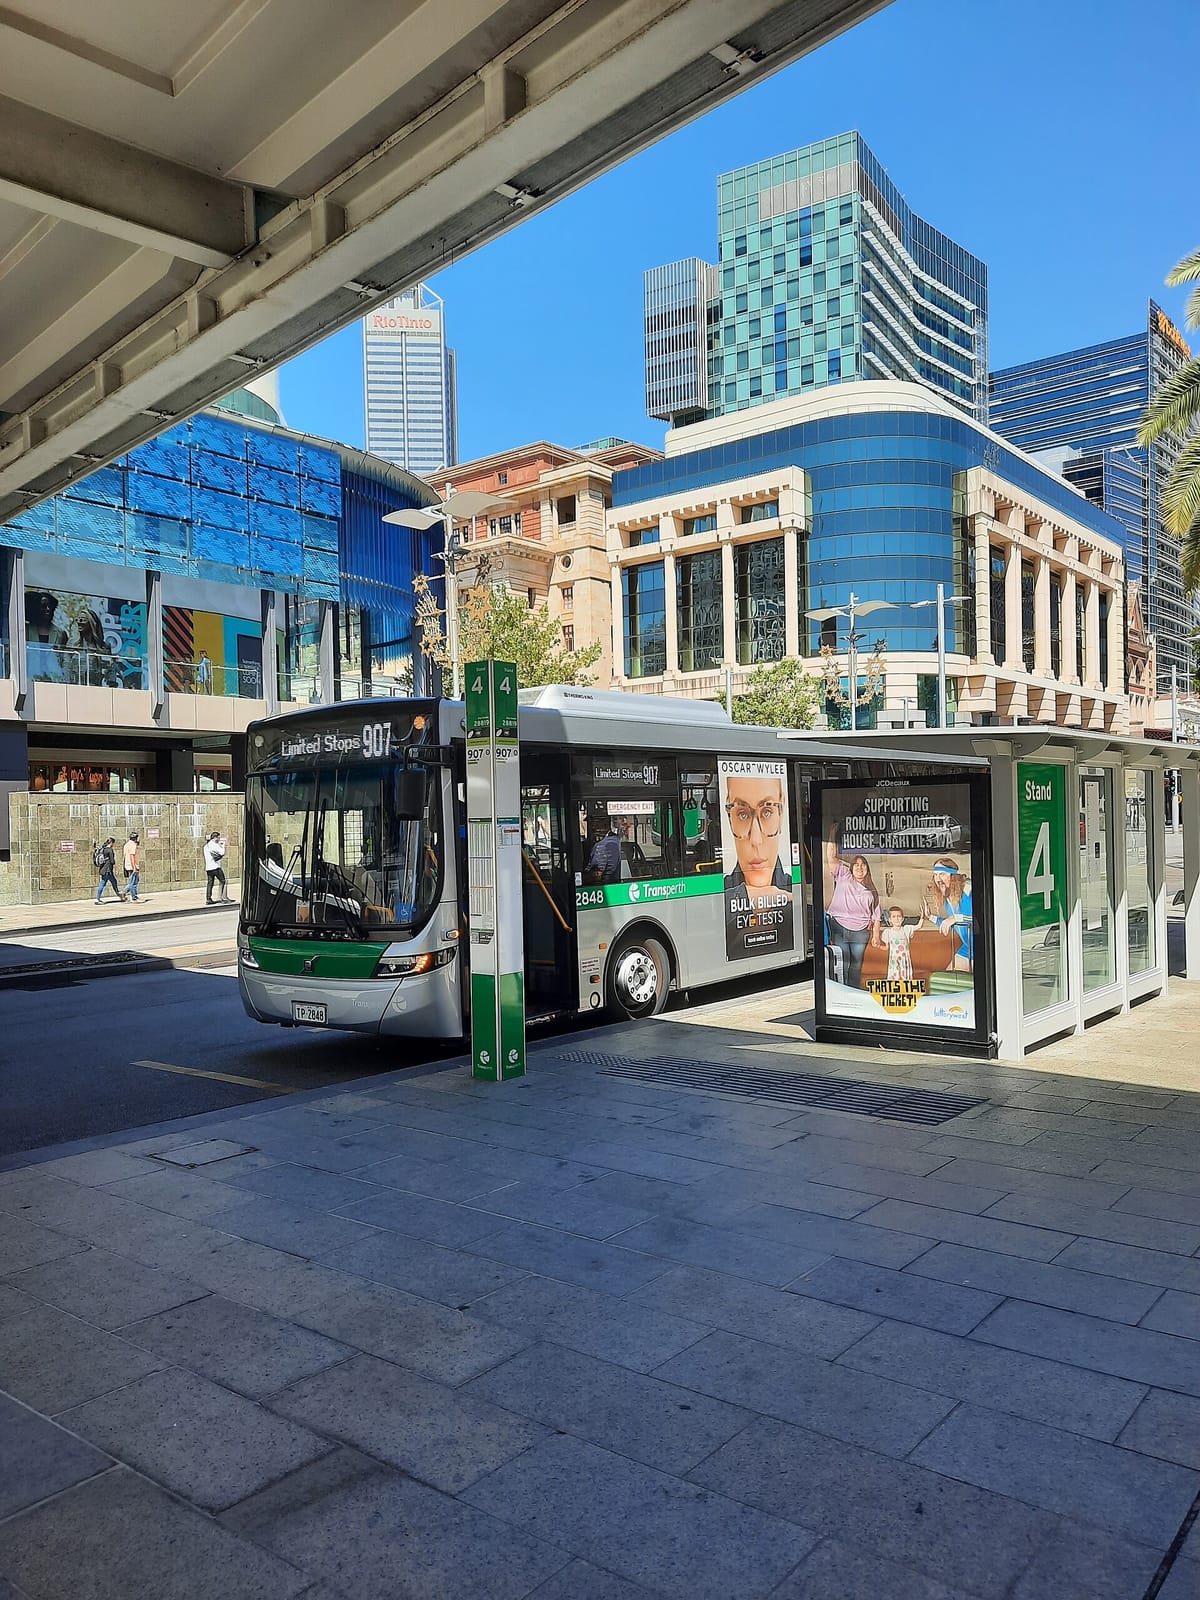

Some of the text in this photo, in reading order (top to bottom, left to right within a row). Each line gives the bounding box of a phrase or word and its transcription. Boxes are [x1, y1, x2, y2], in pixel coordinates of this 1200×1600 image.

[471, 676, 483, 694] 4
[499, 676, 511, 694] 4
[281, 722, 392, 758] Limited Stops 907
[467, 748, 484, 759] 907
[495, 748, 512, 758] 907
[595, 765, 659, 785] Limited Stops 907
[721, 762, 785, 775] OSCAR WYLEE
[1025, 780, 1052, 801] Stand
[864, 796, 929, 813] SUPPORTING
[845, 815, 886, 831] RONALD
[842, 834, 875, 849] HOUSE
[1026, 822, 1055, 910] 4
[575, 890, 604, 906] 2848
[643, 882, 686, 900] Transperth
[730, 894, 788, 913] BULK BILLED
[736, 910, 784, 929] EYE TESTS
[904, 980, 926, 993] THE
[880, 994, 917, 1008] TICKET!
